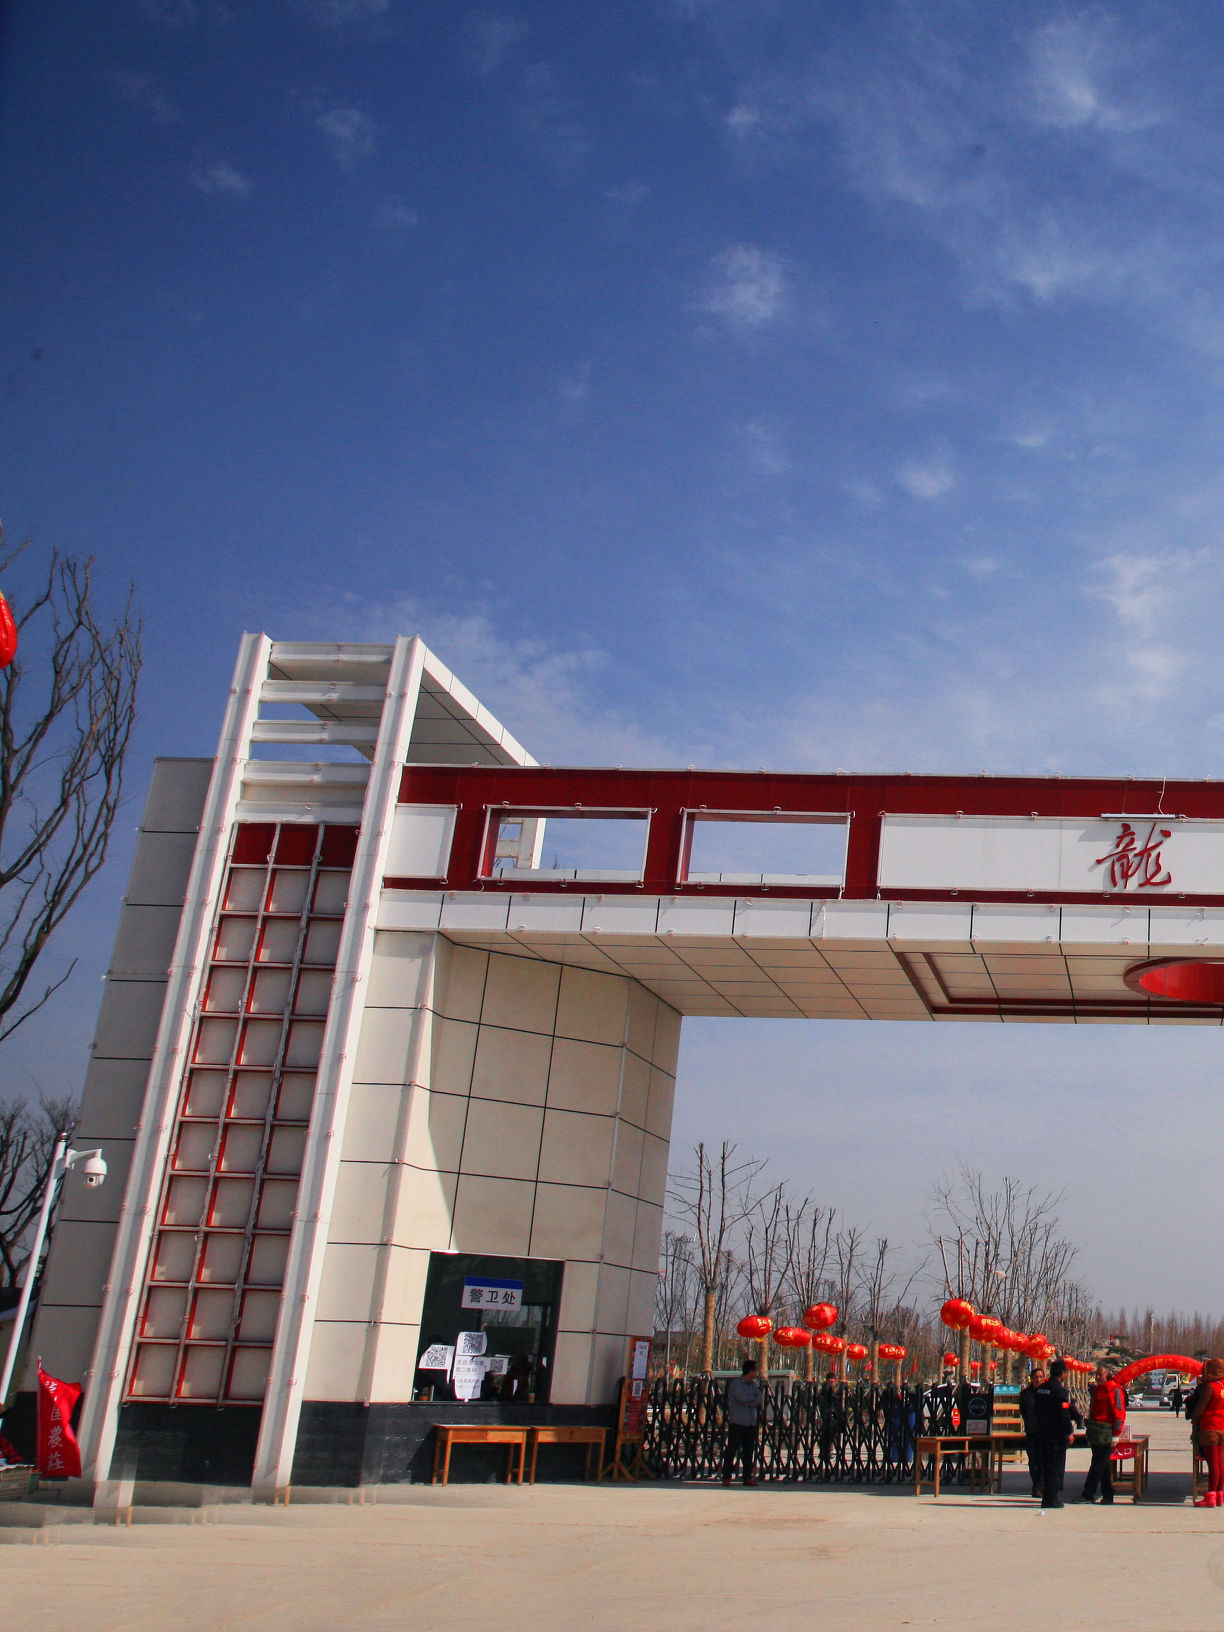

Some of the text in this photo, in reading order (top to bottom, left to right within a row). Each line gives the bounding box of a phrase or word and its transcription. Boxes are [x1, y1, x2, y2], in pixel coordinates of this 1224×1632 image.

[469, 1288, 516, 1305] 警卫处
[1111, 1447, 1133, 1456] 入口
